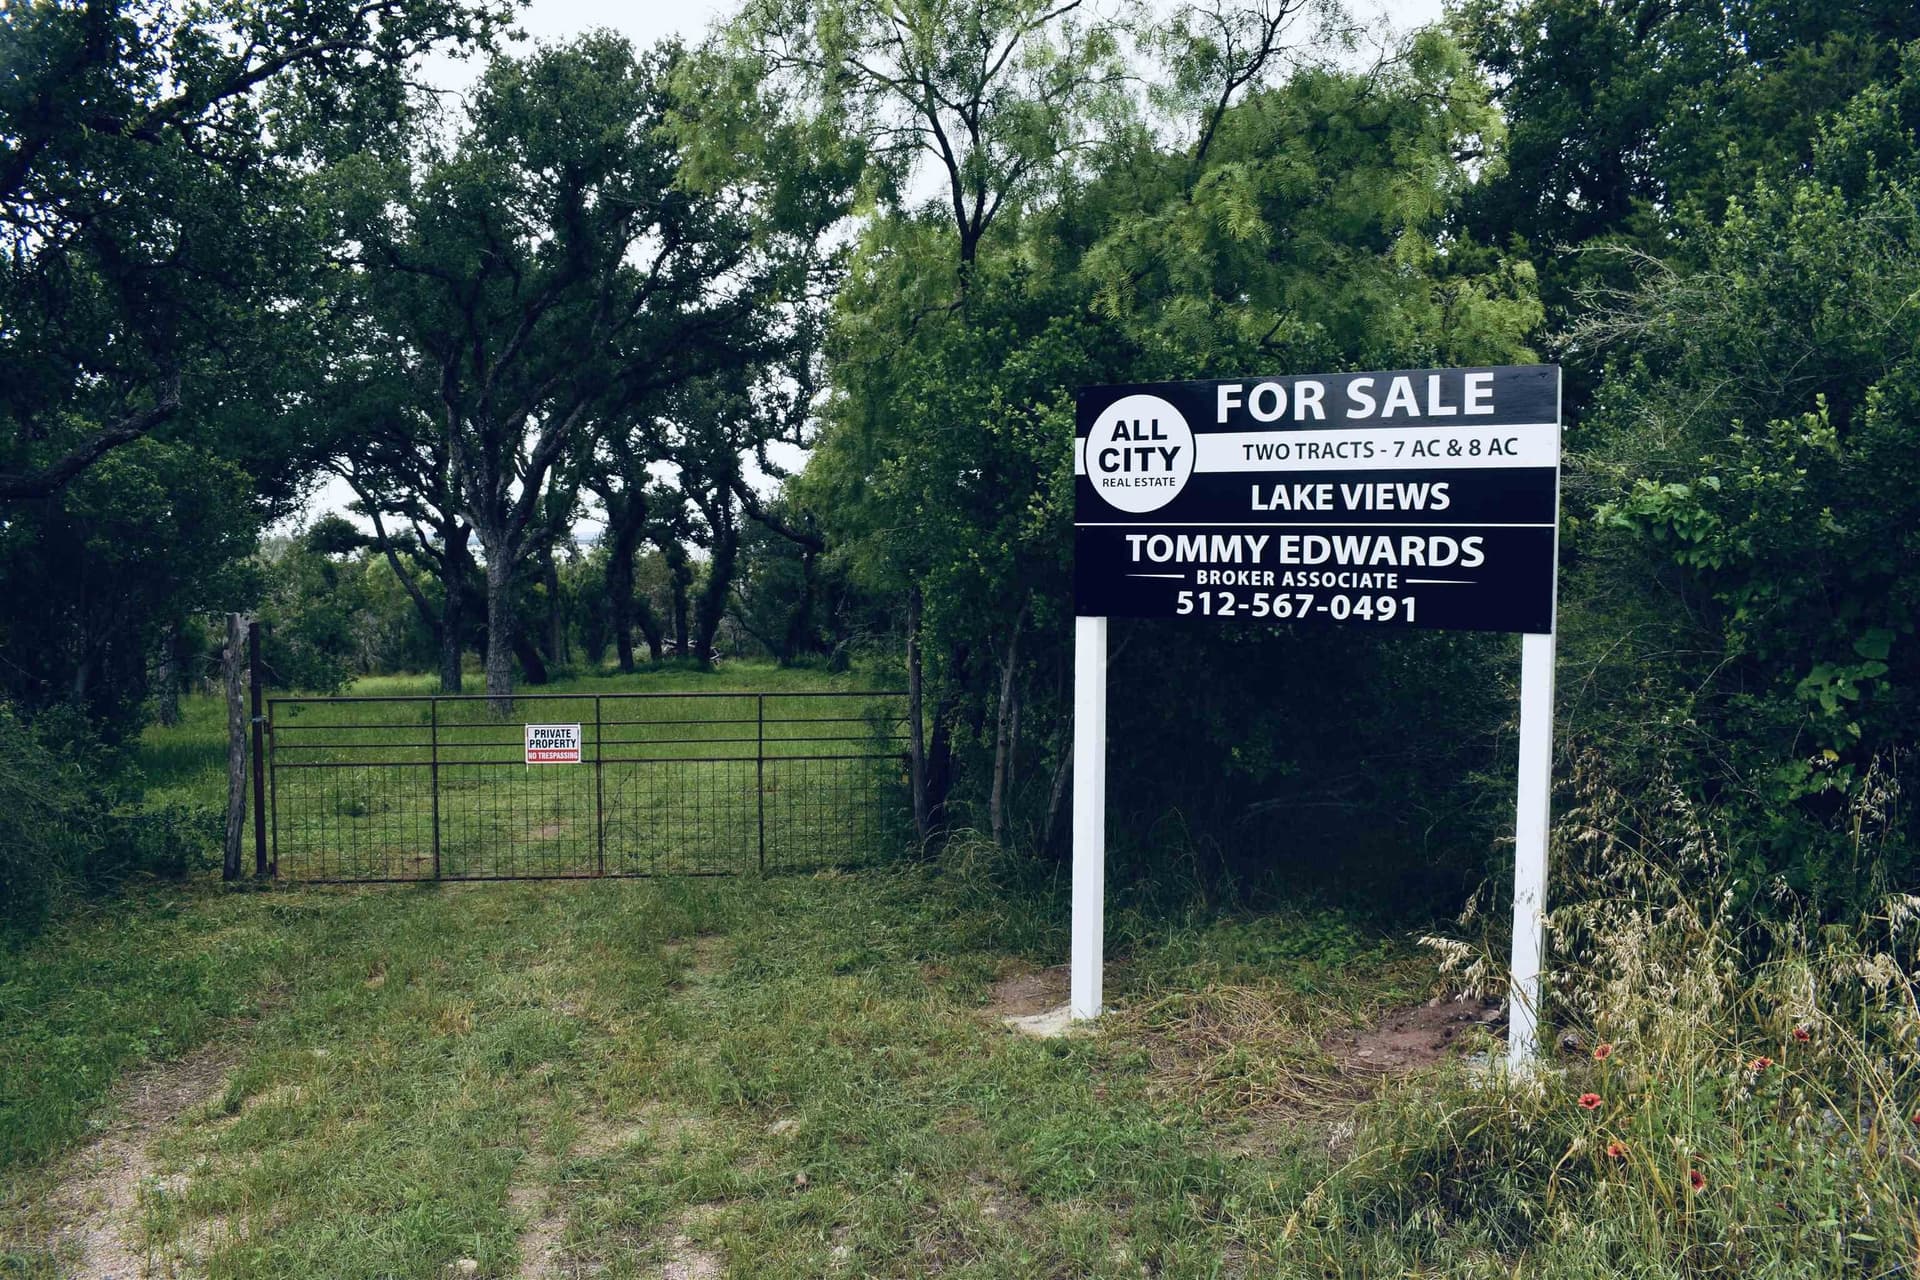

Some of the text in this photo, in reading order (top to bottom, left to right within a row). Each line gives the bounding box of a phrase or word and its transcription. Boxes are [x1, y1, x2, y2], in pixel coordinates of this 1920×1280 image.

[1217, 372, 1496, 424] FOR SALE
[1111, 419, 1168, 442] ALL
[1099, 446, 1181, 473] CITY
[1243, 443, 1290, 461] TWO
[1295, 440, 1375, 460] TRACTS
[1393, 440, 1406, 458] 7
[1411, 439, 1441, 458] AC
[1446, 439, 1463, 457] &
[1468, 438, 1481, 456] 8
[1487, 437, 1519, 456] AC
[1102, 477, 1176, 487] REAL ESTATE
[1251, 482, 1450, 511] LAKE VIEWS
[1126, 534, 1485, 568] TOMMY EDWARDS
[1197, 569, 1399, 589] BROKER ASSOCIATE
[1176, 590, 1416, 622] 512-567-0491
[529, 739, 577, 748] PROPERTY
[534, 729, 571, 738] PRIVATE
[528, 751, 578, 760] NO TRESPASSING
